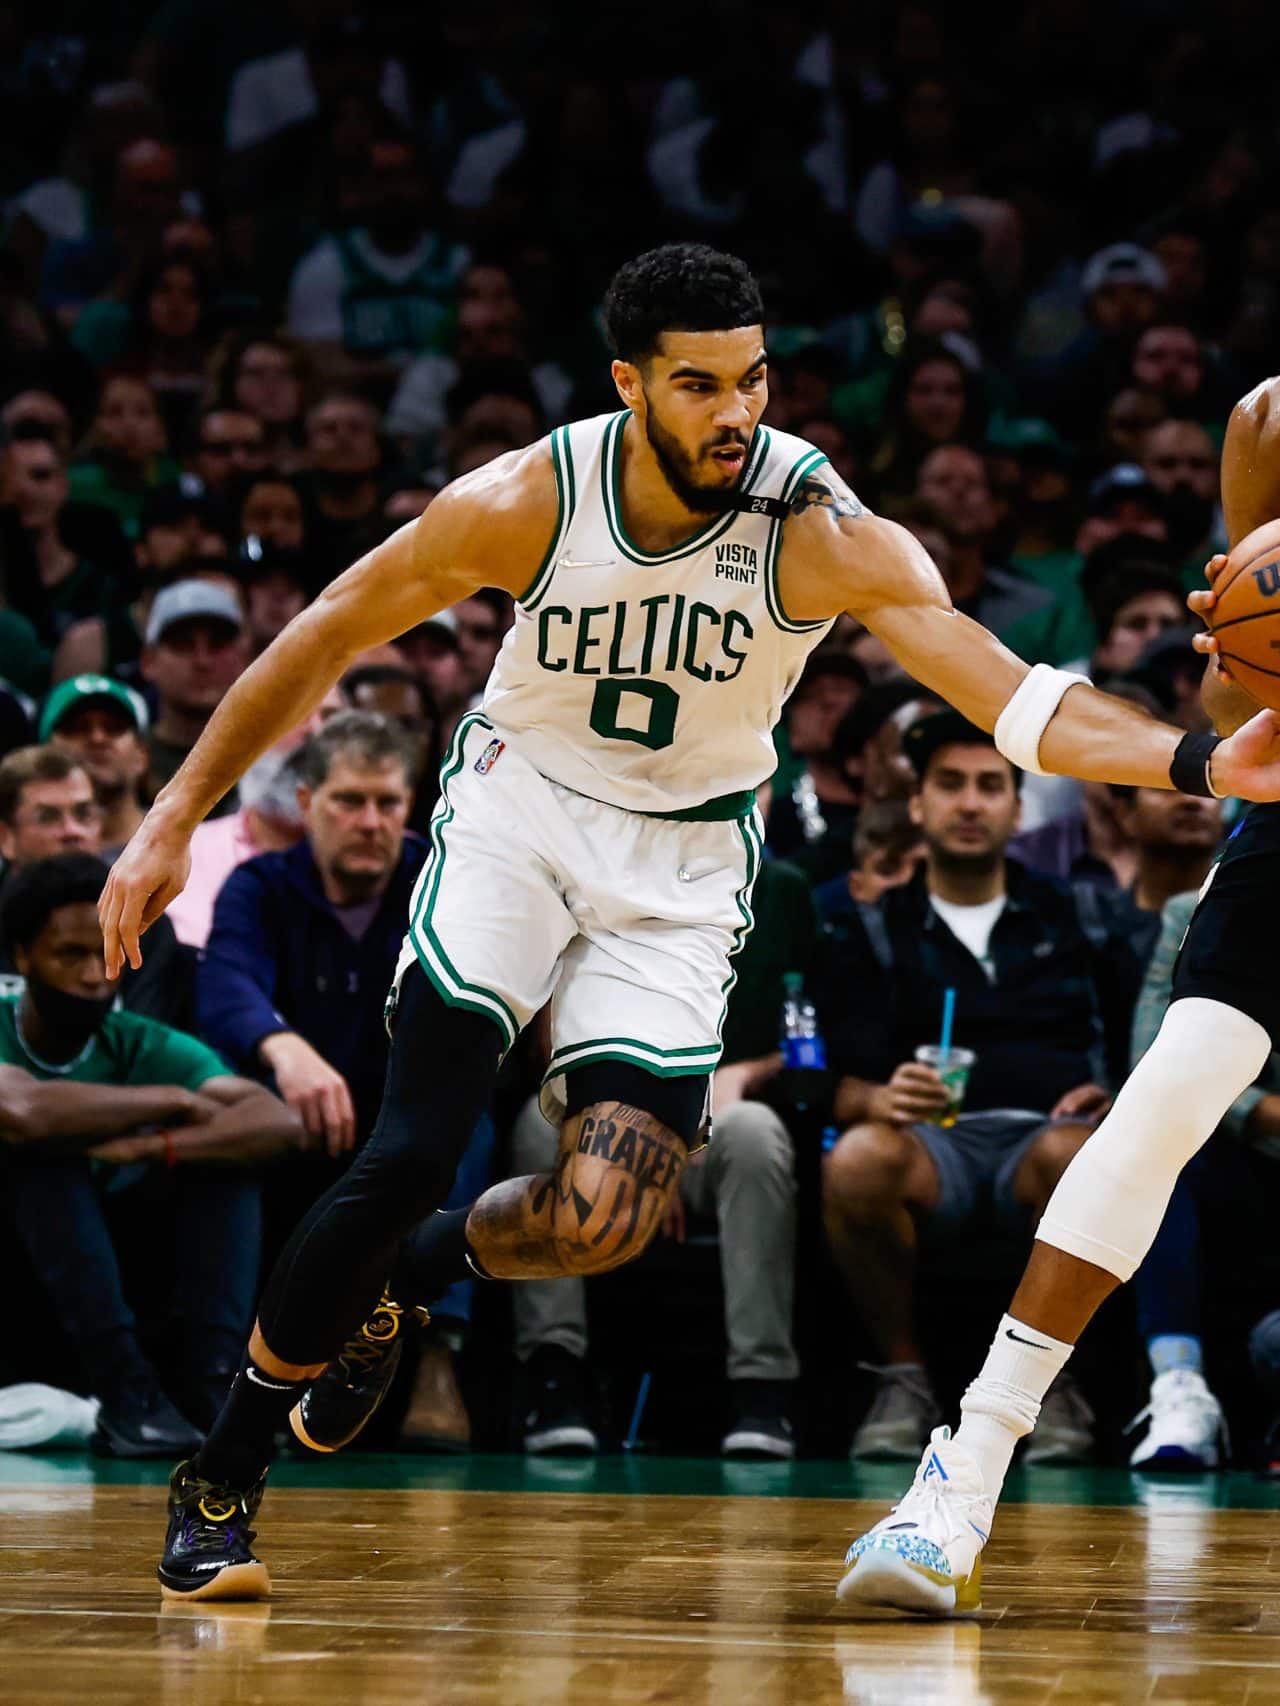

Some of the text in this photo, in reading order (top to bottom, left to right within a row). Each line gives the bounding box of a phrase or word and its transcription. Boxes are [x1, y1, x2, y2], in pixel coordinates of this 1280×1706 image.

[752, 499, 768, 512] 24
[715, 544, 758, 567] VISTA
[715, 564, 757, 584] PRINT
[538, 594, 754, 682] CELTICS
[589, 678, 680, 750] 0
